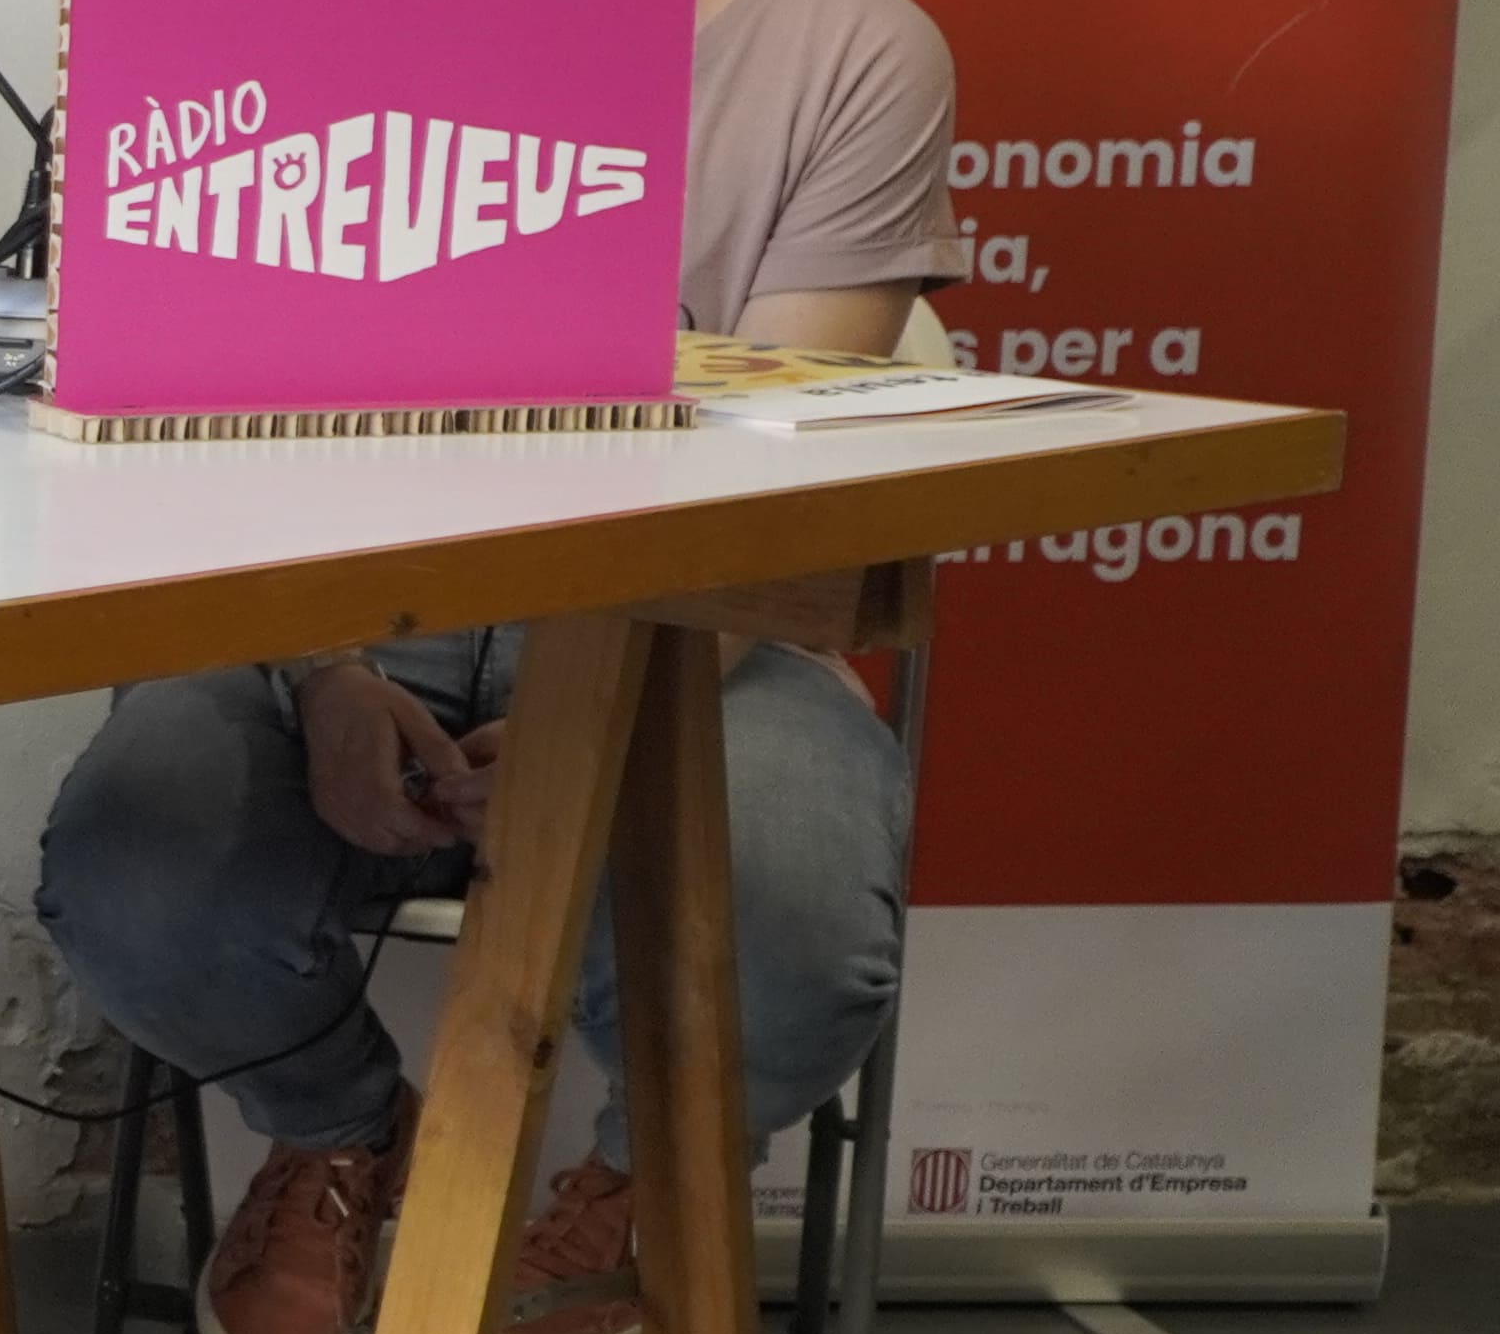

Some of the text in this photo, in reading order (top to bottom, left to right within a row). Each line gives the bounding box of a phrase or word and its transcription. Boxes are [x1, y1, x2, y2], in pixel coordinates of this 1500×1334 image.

[107, 79, 267, 187] RÀDIO
[947, 119, 1256, 190] onomia
[999, 325, 1133, 377] per
[1149, 325, 1202, 377] a
[979, 1151, 1226, 1174] Generalitat de Catalunya
[979, 1172, 1248, 1196] Departament d'Empresa
[990, 1197, 1063, 1216] Treball
